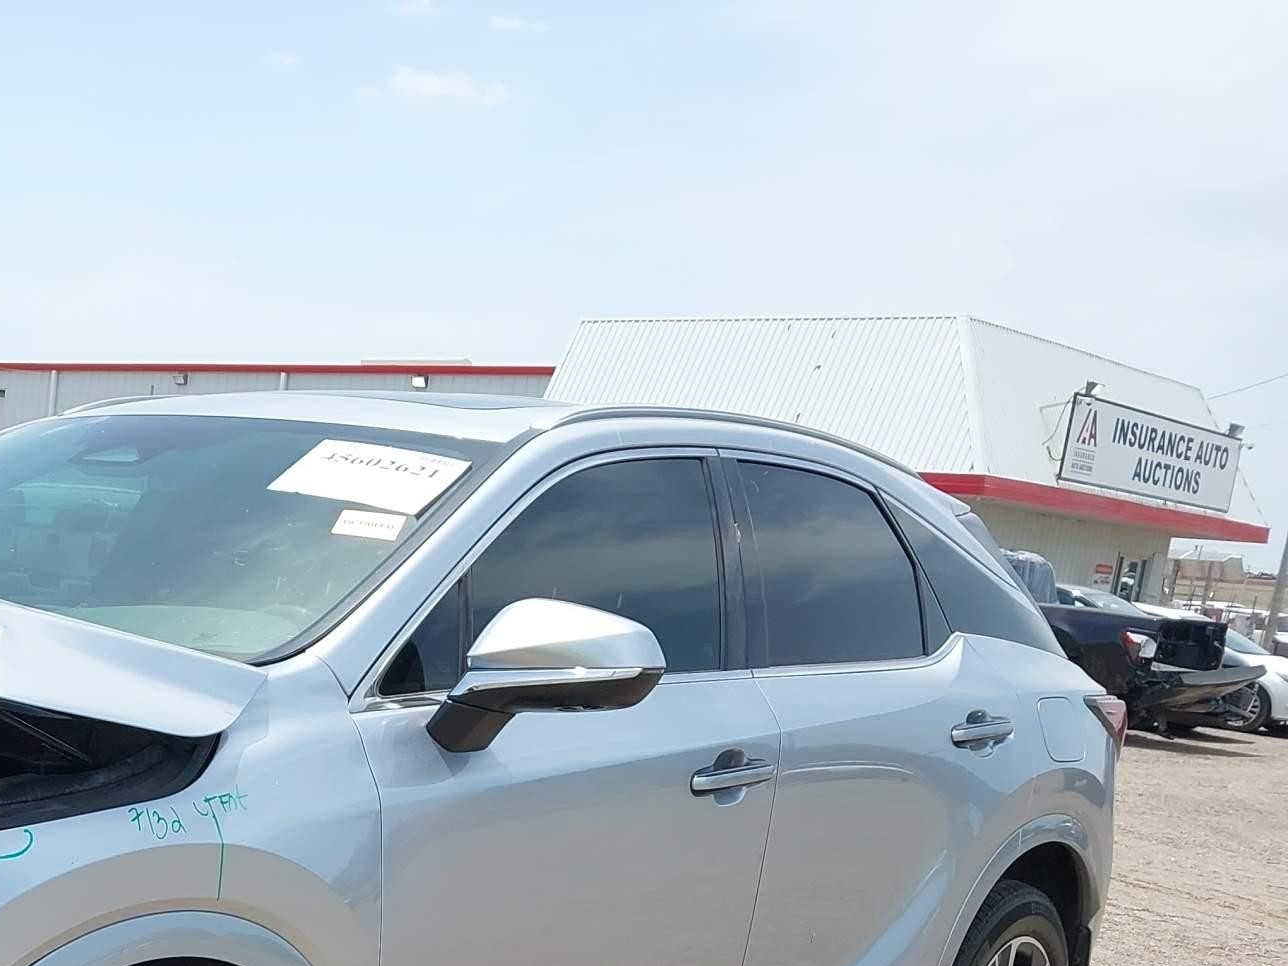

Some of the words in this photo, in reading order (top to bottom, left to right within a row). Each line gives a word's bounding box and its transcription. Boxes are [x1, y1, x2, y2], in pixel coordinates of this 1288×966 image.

[1112, 417, 1194, 461] INSURANCE
[1194, 440, 1229, 470] AUTO
[1132, 457, 1201, 495] AUCTIONS
